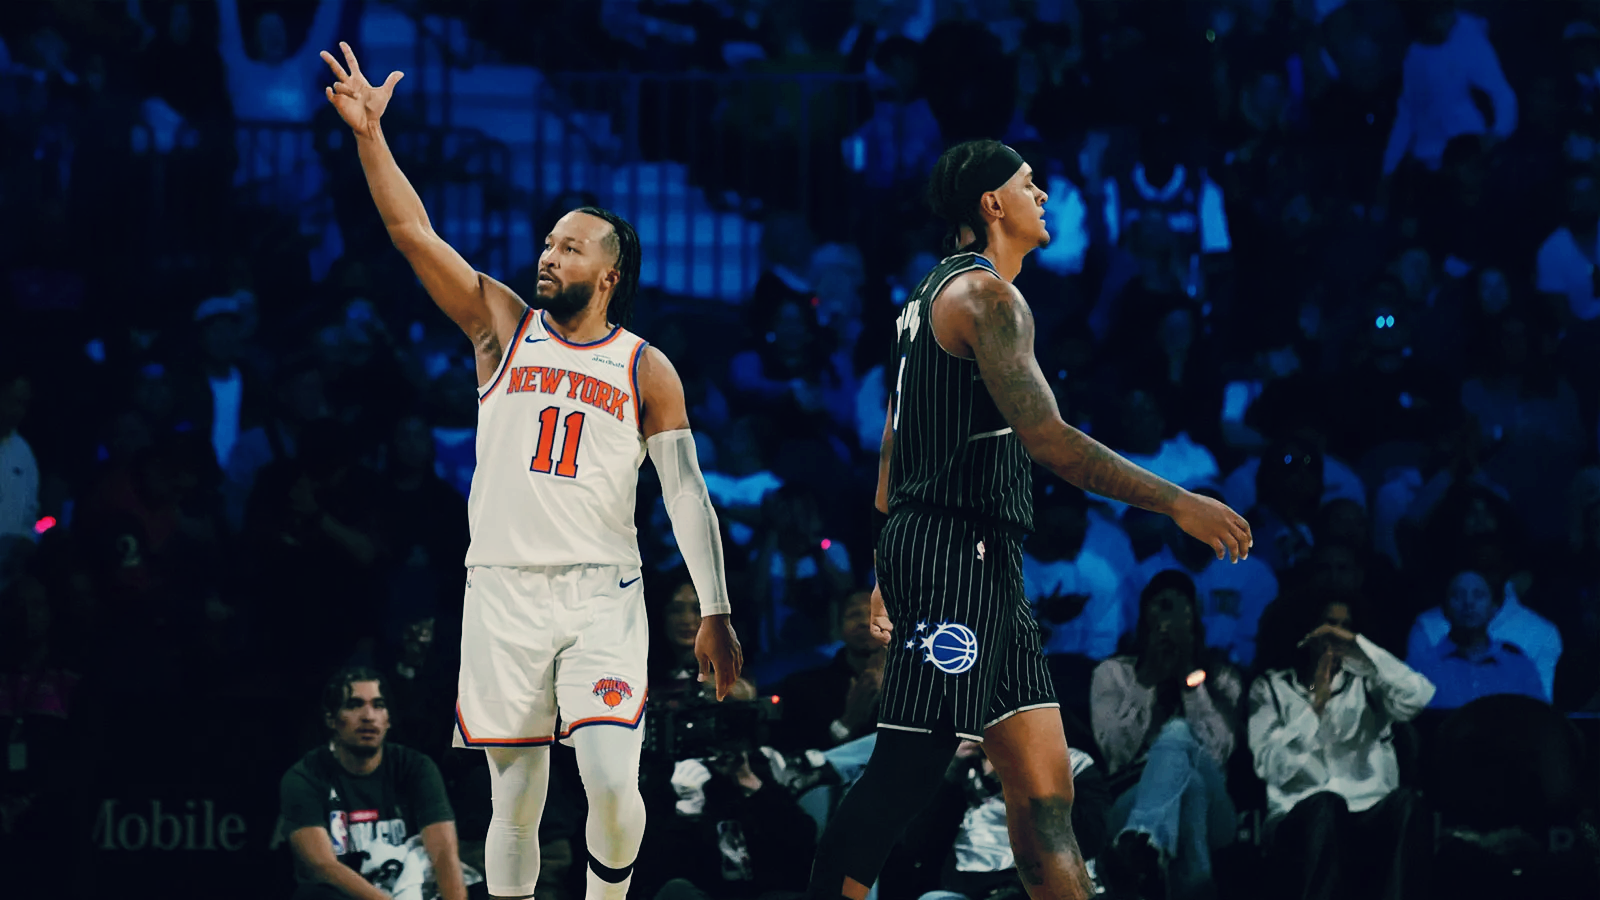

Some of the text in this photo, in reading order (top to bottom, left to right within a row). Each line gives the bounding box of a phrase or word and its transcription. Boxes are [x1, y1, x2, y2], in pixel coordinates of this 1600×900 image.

[506, 366, 630, 422] NEW YORK
[529, 406, 586, 479] 11
